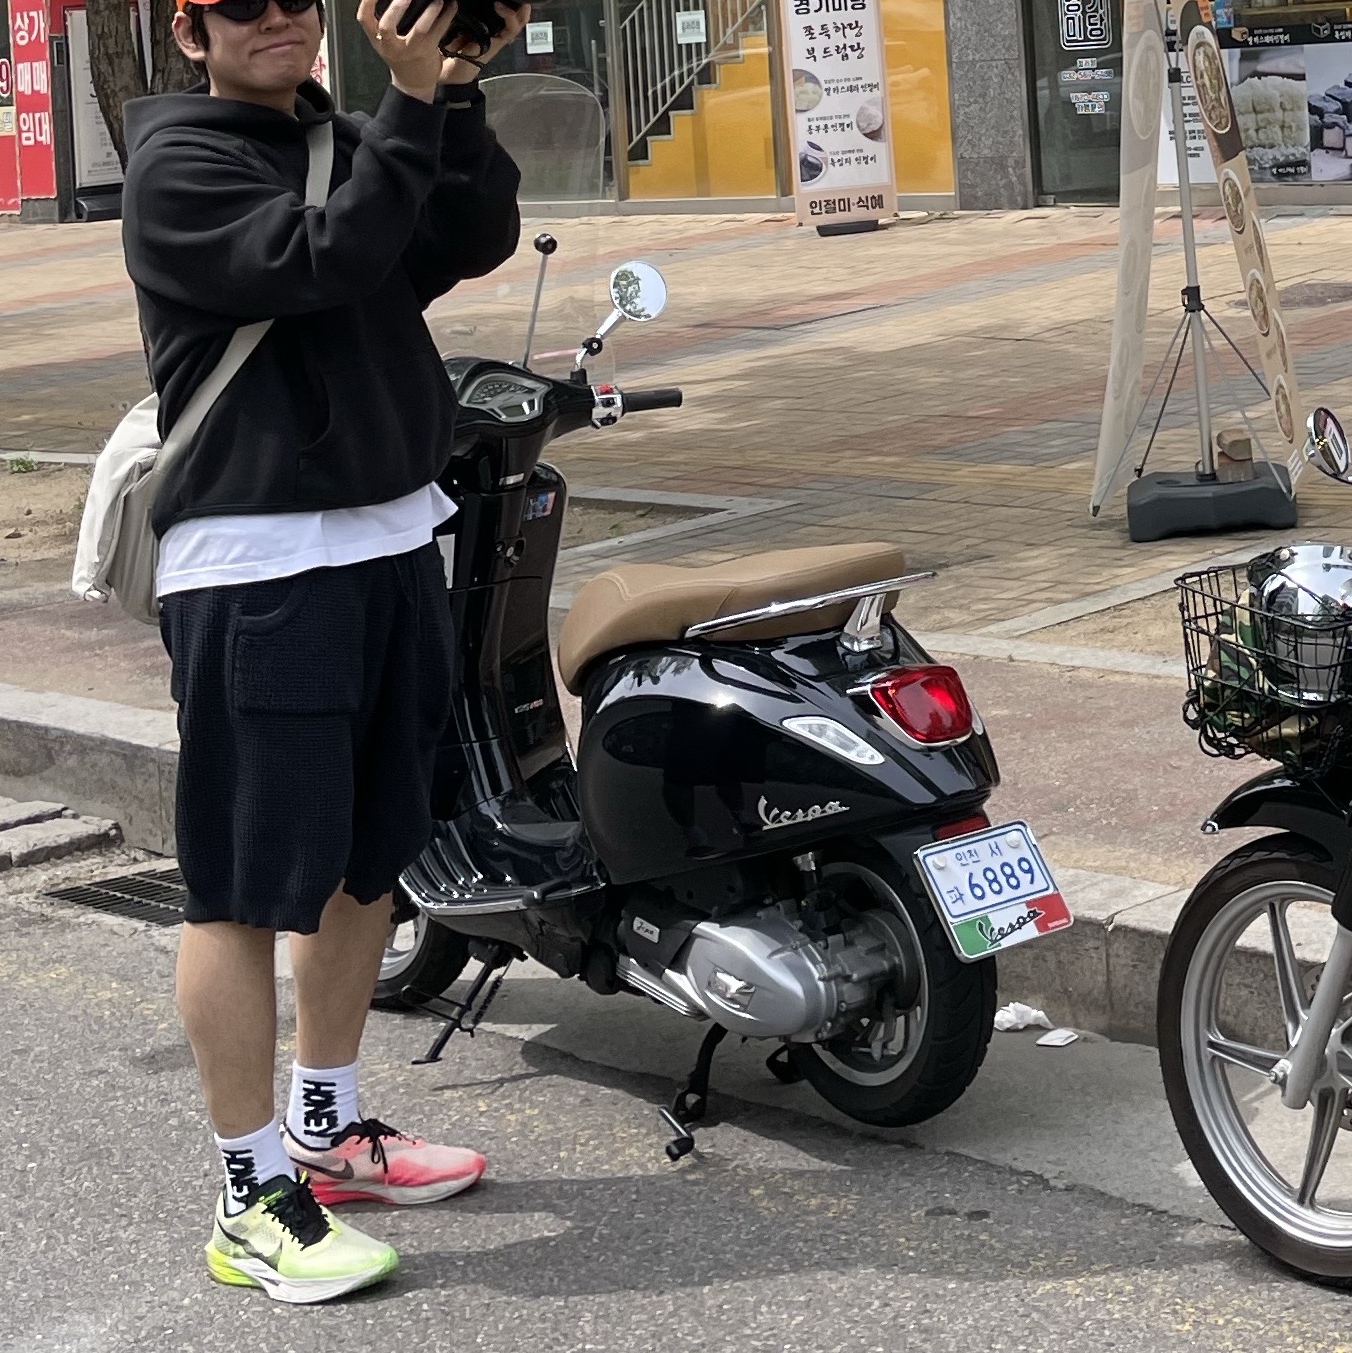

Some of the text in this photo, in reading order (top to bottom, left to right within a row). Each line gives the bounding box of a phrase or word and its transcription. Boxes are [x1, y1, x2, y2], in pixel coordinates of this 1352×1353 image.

[13, 10, 46, 46] 상가
[16, 60, 48, 96] 매매
[19, 112, 51, 146] 임대
[757, 794, 850, 830] Vespa
[954, 840, 1003, 867] 인천 서
[968, 856, 1035, 901] 6889
[975, 907, 1046, 949] Vespa
[302, 1079, 342, 1139] HONEY
